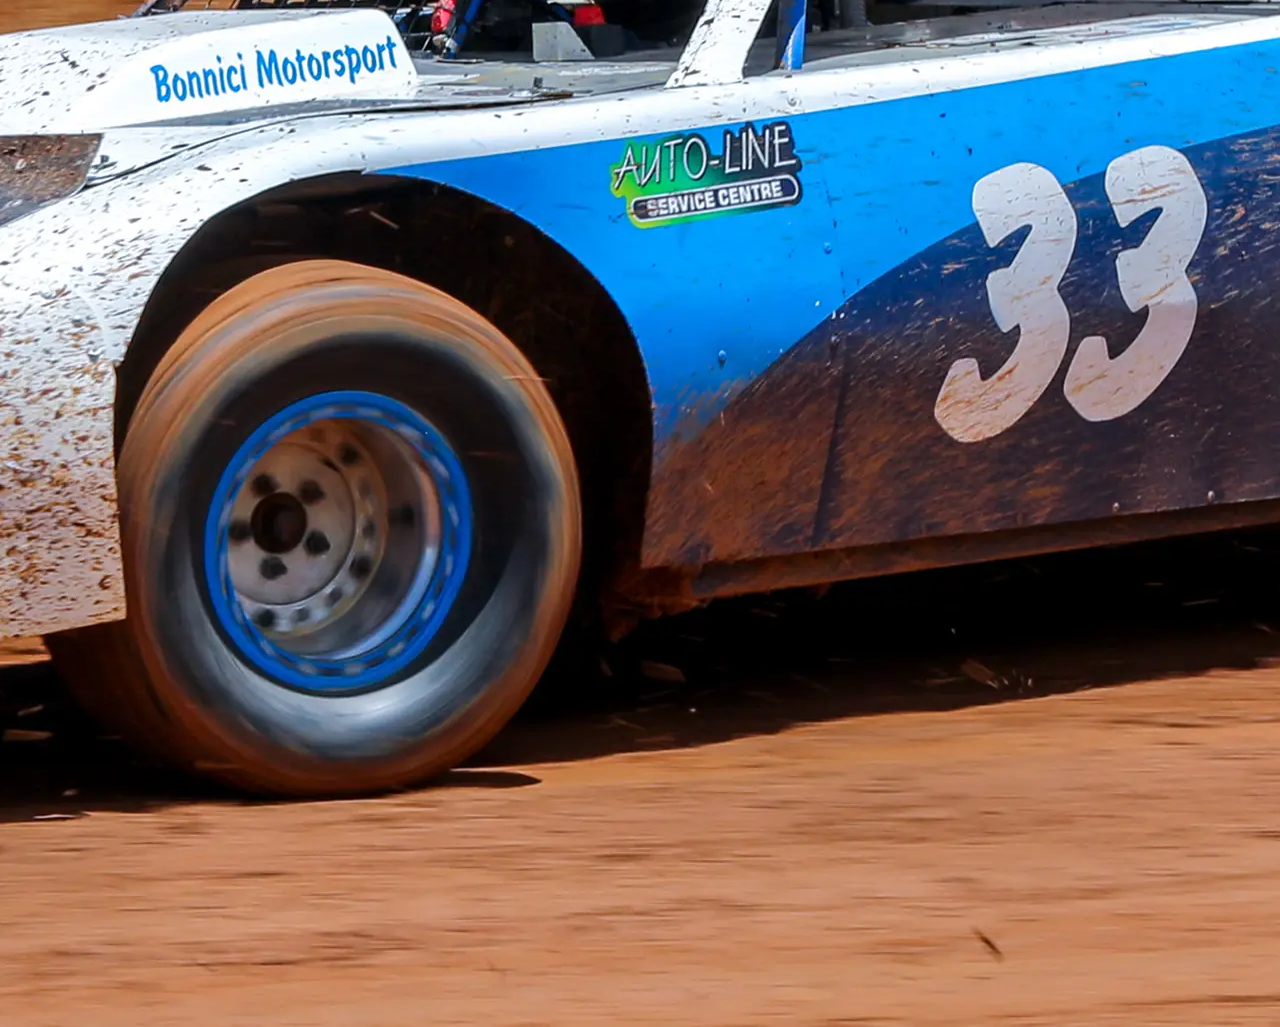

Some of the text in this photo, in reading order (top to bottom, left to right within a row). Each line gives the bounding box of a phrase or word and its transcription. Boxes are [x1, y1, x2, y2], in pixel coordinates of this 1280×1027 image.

[150, 35, 397, 103] Bonnici Motorsport
[613, 125, 797, 188] AUTO-LINE
[646, 181, 783, 217] SERVICE CENTRE
[934, 145, 1208, 443] 33
